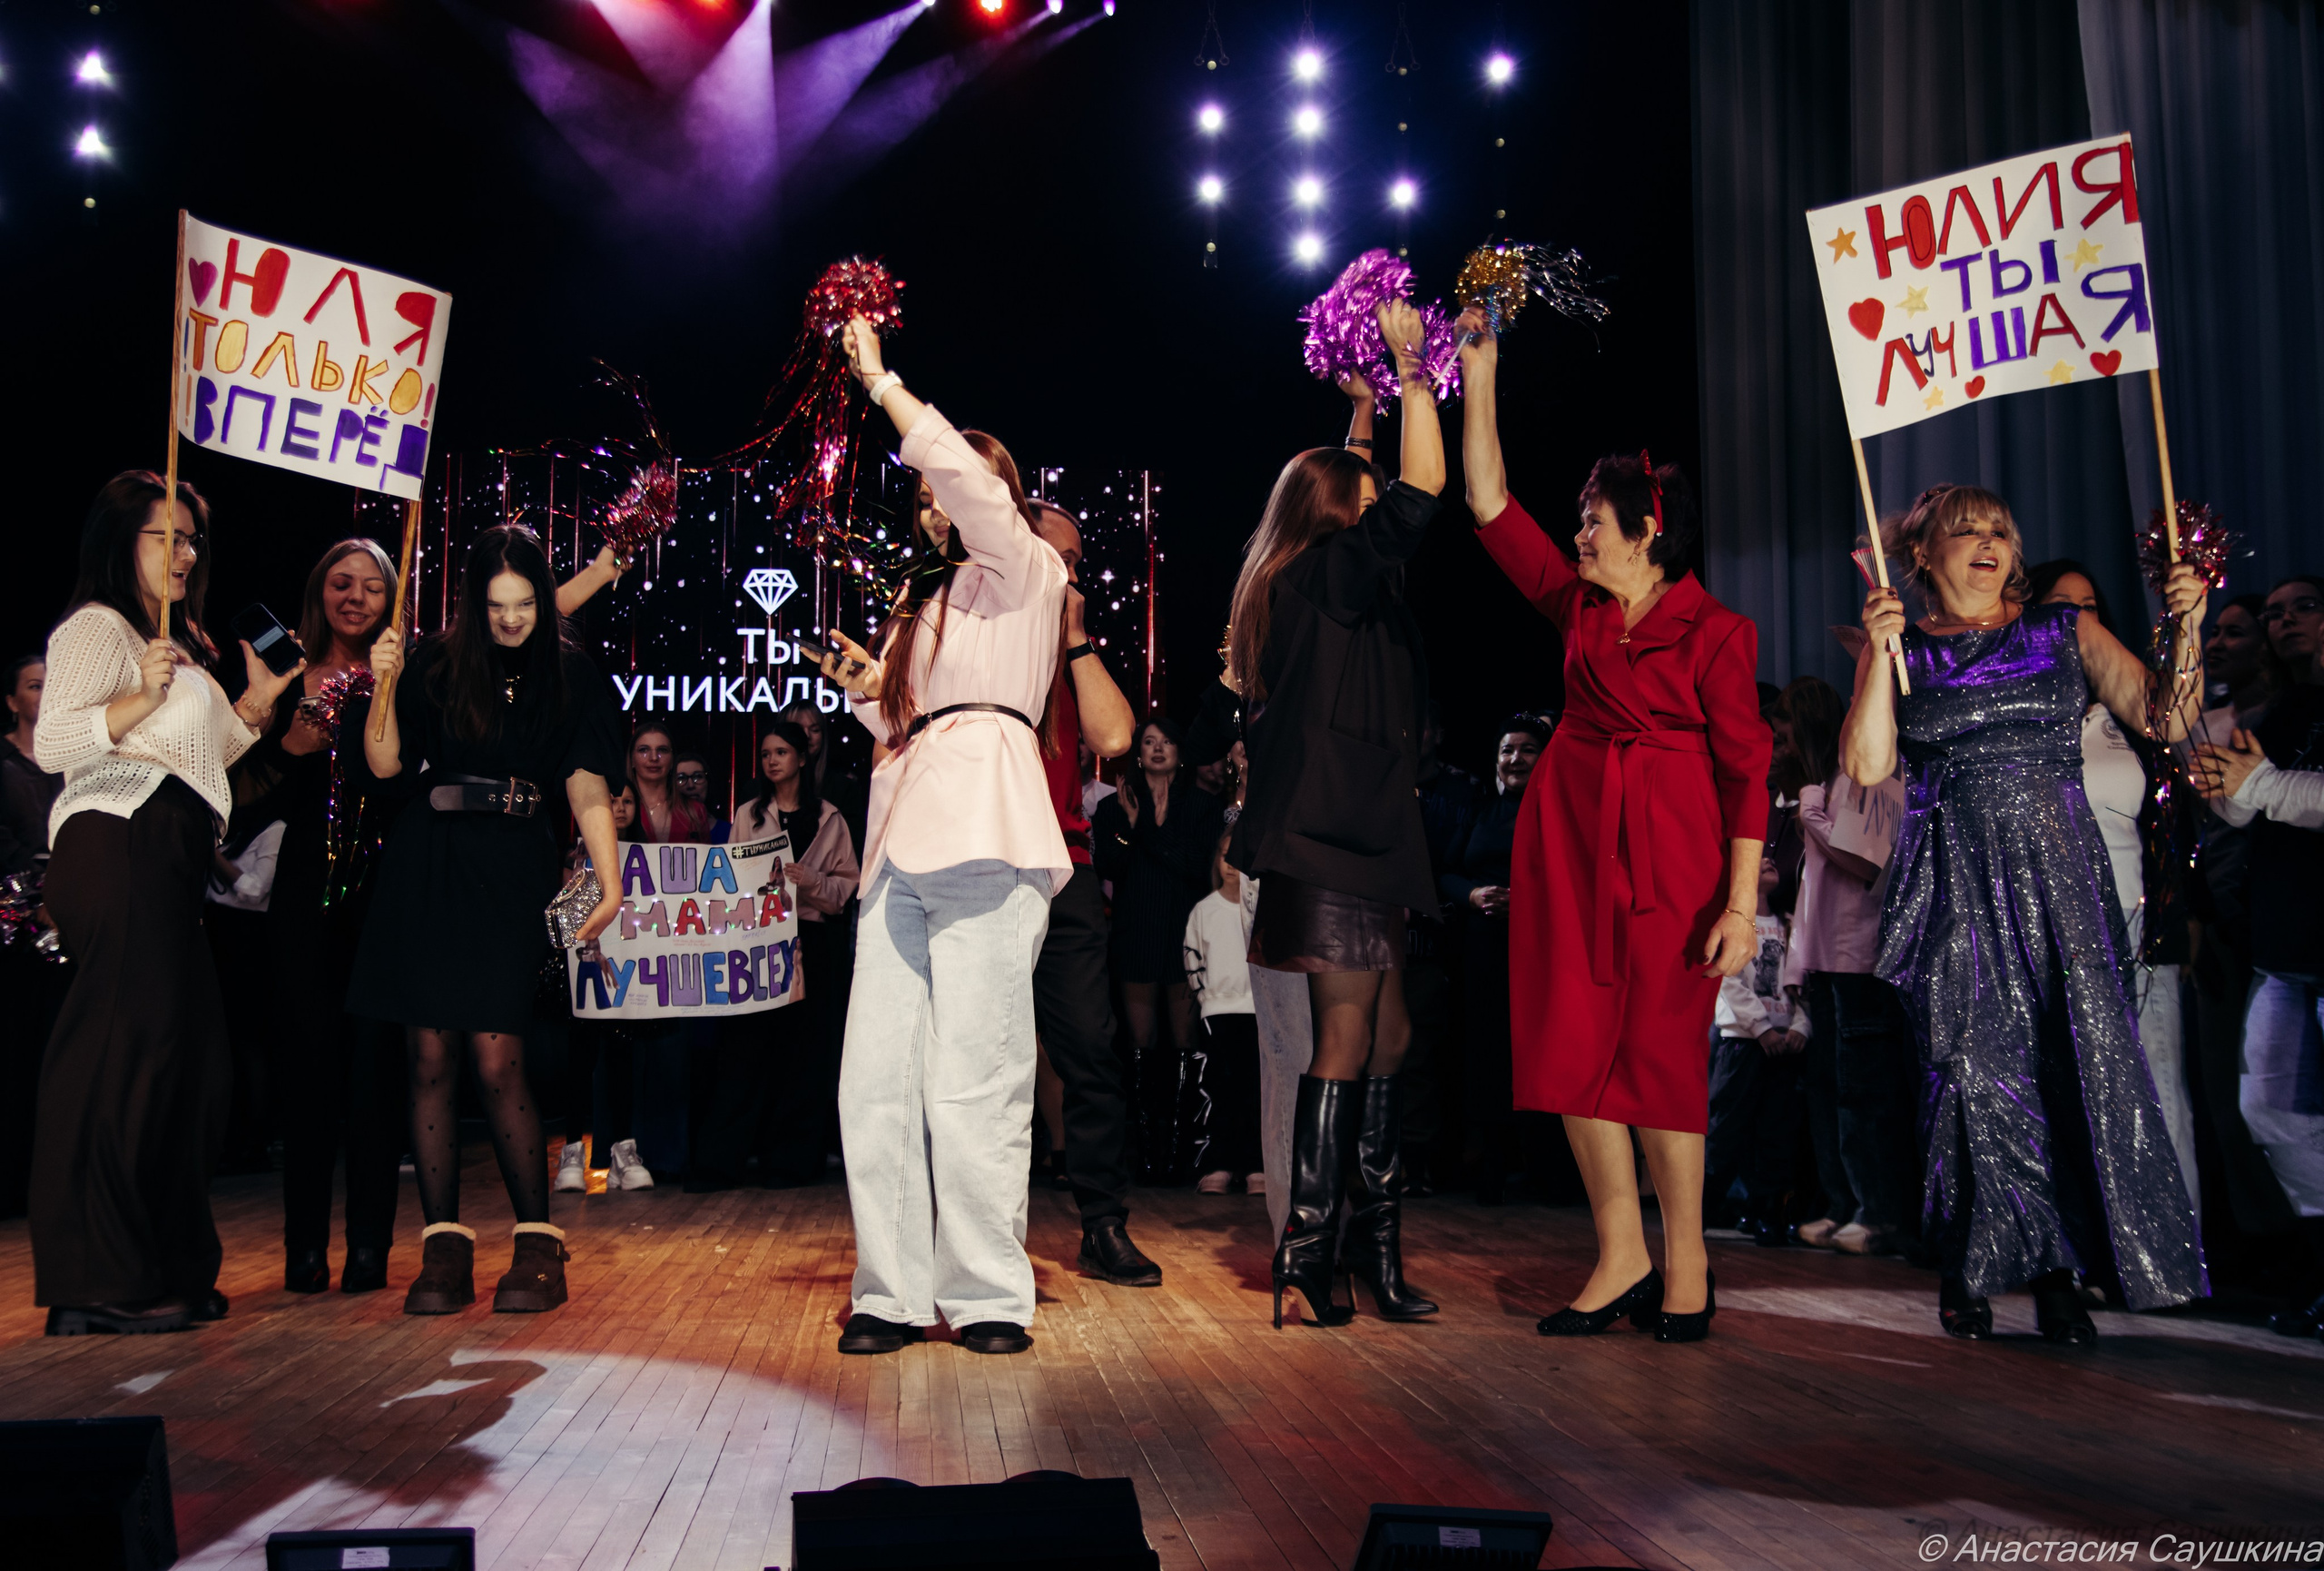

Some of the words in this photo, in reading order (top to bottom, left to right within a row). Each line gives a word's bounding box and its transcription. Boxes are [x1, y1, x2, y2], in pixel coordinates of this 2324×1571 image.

[1865, 142, 2141, 280] ЮЛИЯ
[218, 237, 438, 367] ЮЛЯ
[1939, 239, 2061, 313] ТЫ
[1875, 262, 2152, 407] ЛУЧШАЯ
[736, 627, 801, 665] ТЫ
[611, 675, 852, 715] УНИКАЛЬ
[586, 844, 739, 896] АША
[619, 892, 788, 940] МАМА
